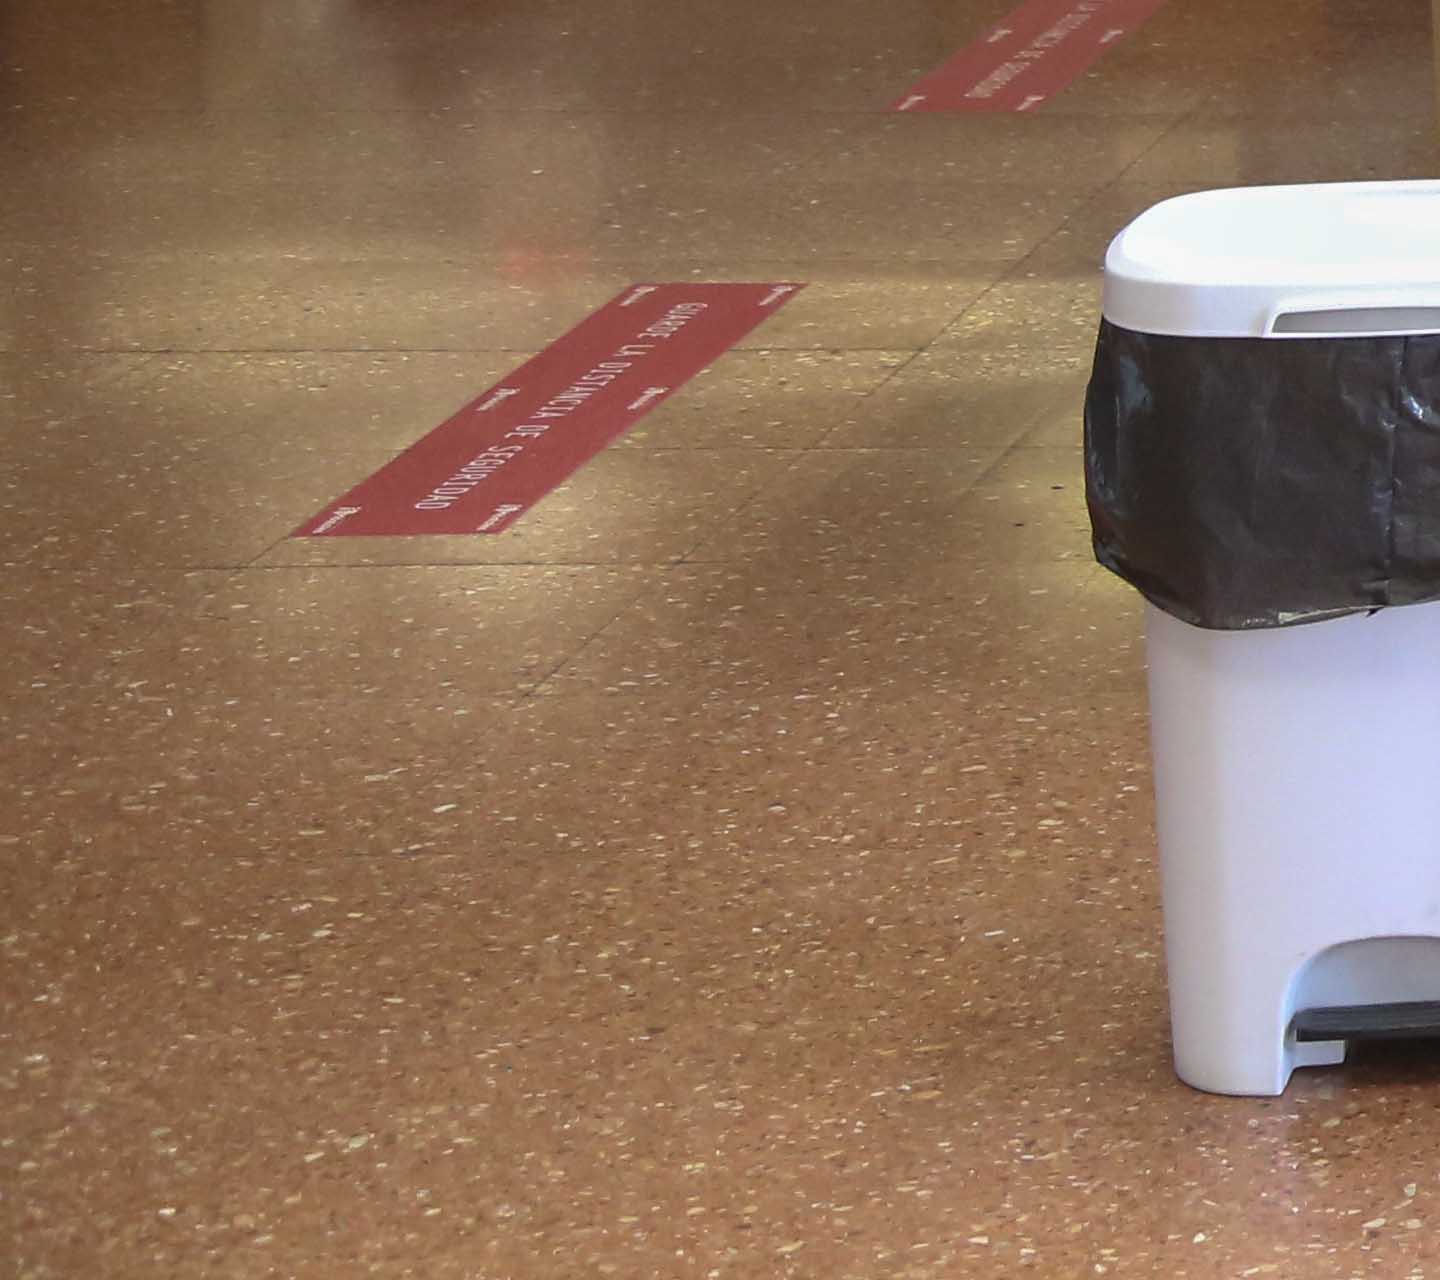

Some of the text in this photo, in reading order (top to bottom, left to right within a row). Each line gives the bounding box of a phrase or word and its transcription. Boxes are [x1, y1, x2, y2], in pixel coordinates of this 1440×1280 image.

[613, 344, 656, 356] LA
[531, 361, 632, 420] DISTANCIA
[505, 424, 551, 439] DE
[414, 445, 524, 510] SEGURIDAD
